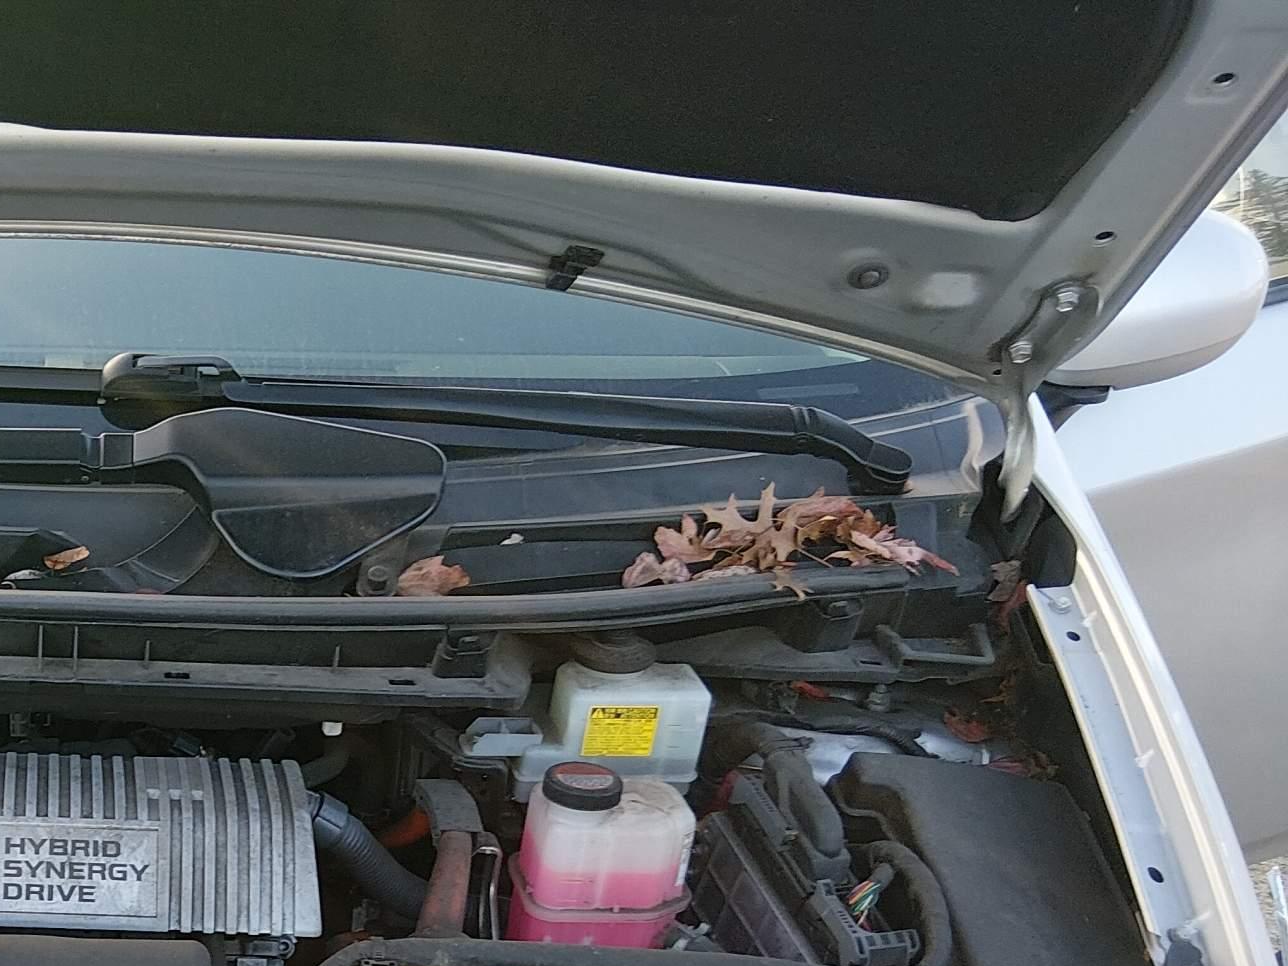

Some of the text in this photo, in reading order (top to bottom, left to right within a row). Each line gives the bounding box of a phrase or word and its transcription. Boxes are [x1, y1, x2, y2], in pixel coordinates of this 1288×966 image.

[4, 837, 122, 858] HYBRID
[3, 859, 150, 881] SYNERGY
[2, 882, 97, 903] DRIVE
